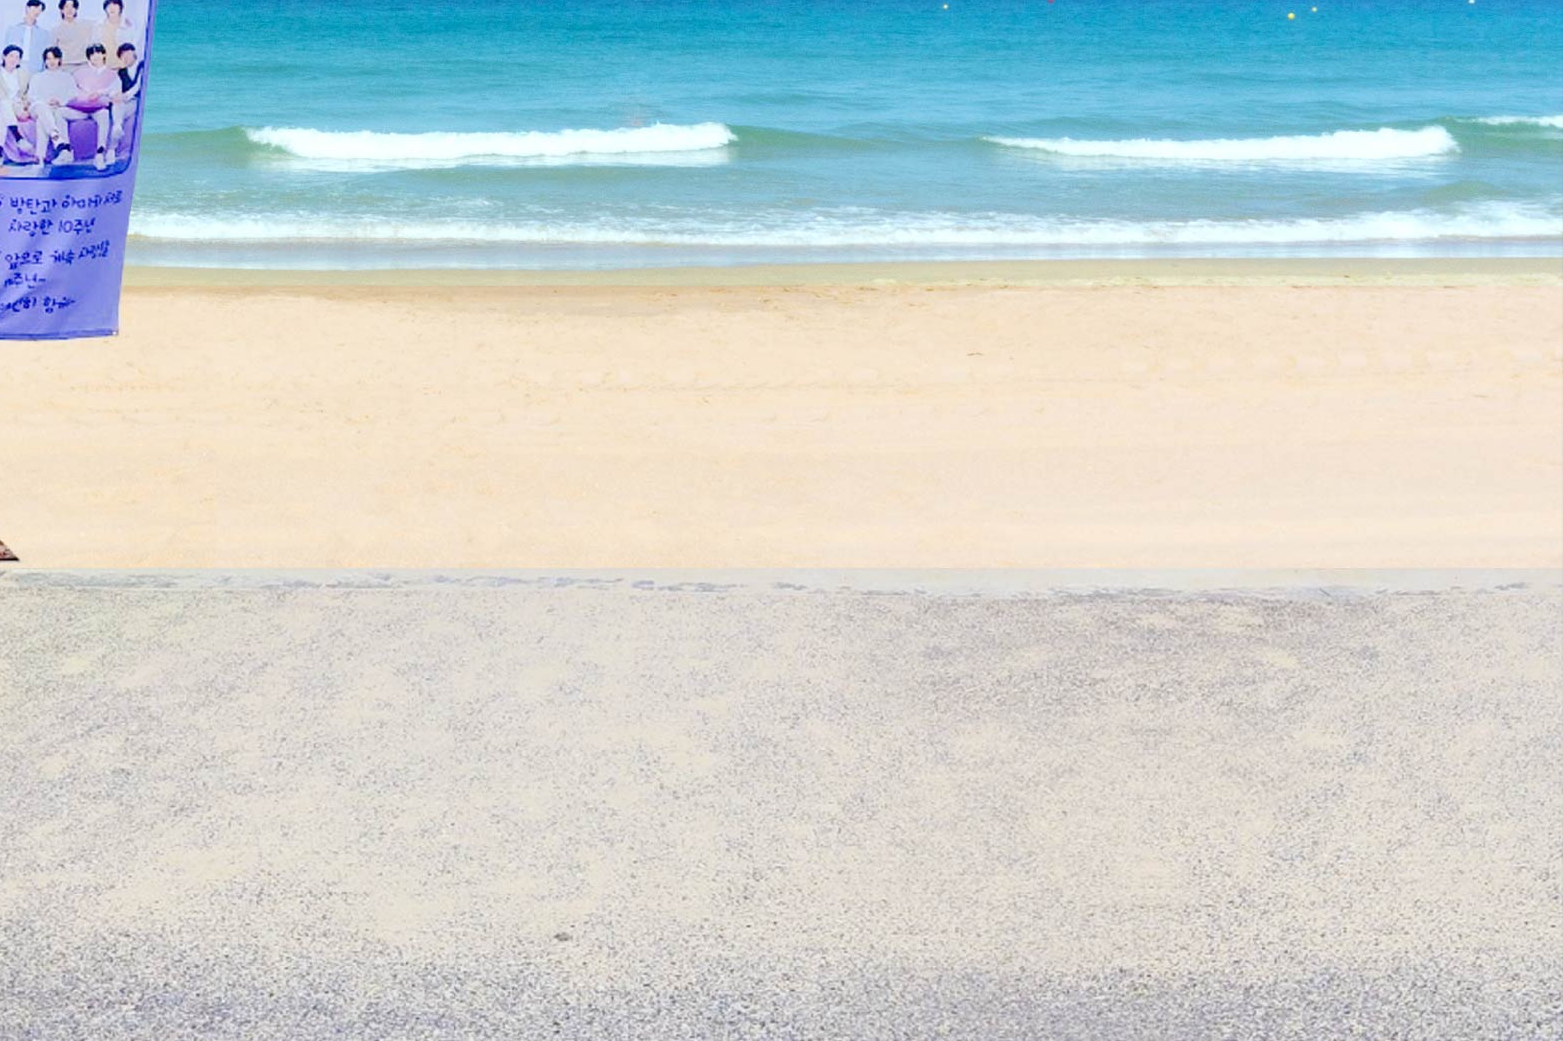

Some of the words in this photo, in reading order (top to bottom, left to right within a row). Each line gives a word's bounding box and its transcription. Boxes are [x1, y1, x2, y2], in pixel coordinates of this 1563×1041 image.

[9, 196, 58, 215] 방탄과
[8, 218, 54, 238] 사랑한
[4, 250, 44, 271] 앞으로
